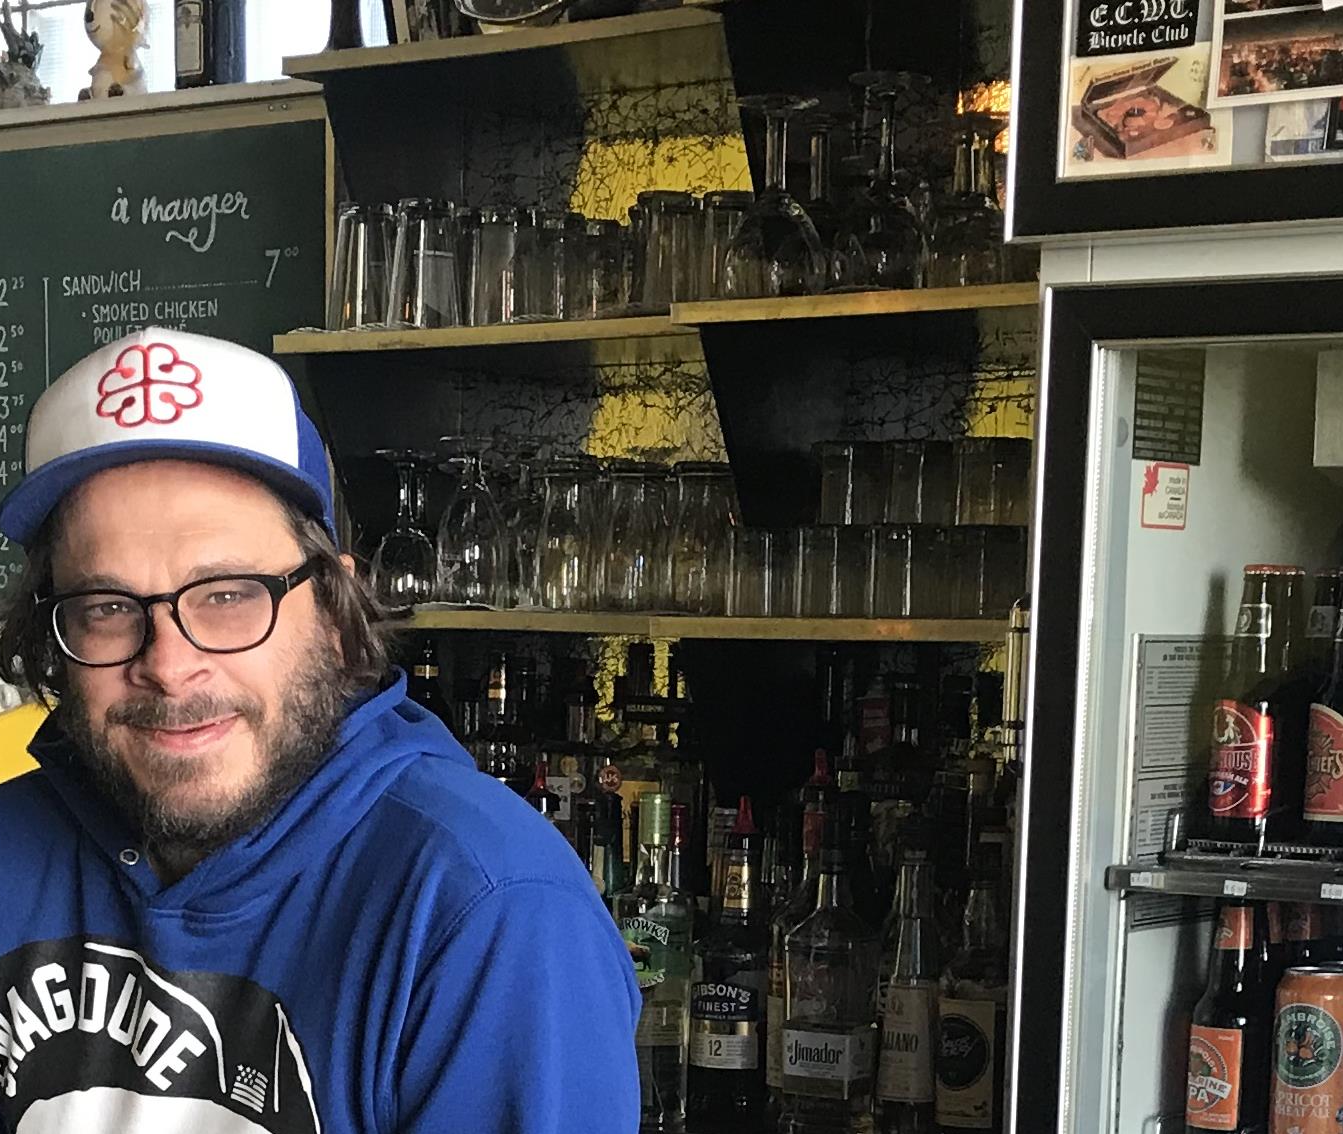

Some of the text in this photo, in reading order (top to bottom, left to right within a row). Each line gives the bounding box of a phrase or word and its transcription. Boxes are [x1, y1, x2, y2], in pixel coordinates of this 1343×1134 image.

[1088, 23, 1190, 51] Bicycle Club
[142, 190, 251, 252] manger
[62, 270, 142, 295] SANDWICH
[92, 298, 219, 324] SMOKED CHICKEN
[707, 1039, 722, 1057] 12
[788, 1039, 844, 1066] Jimador
[1308, 1107, 1331, 1119] ALE
